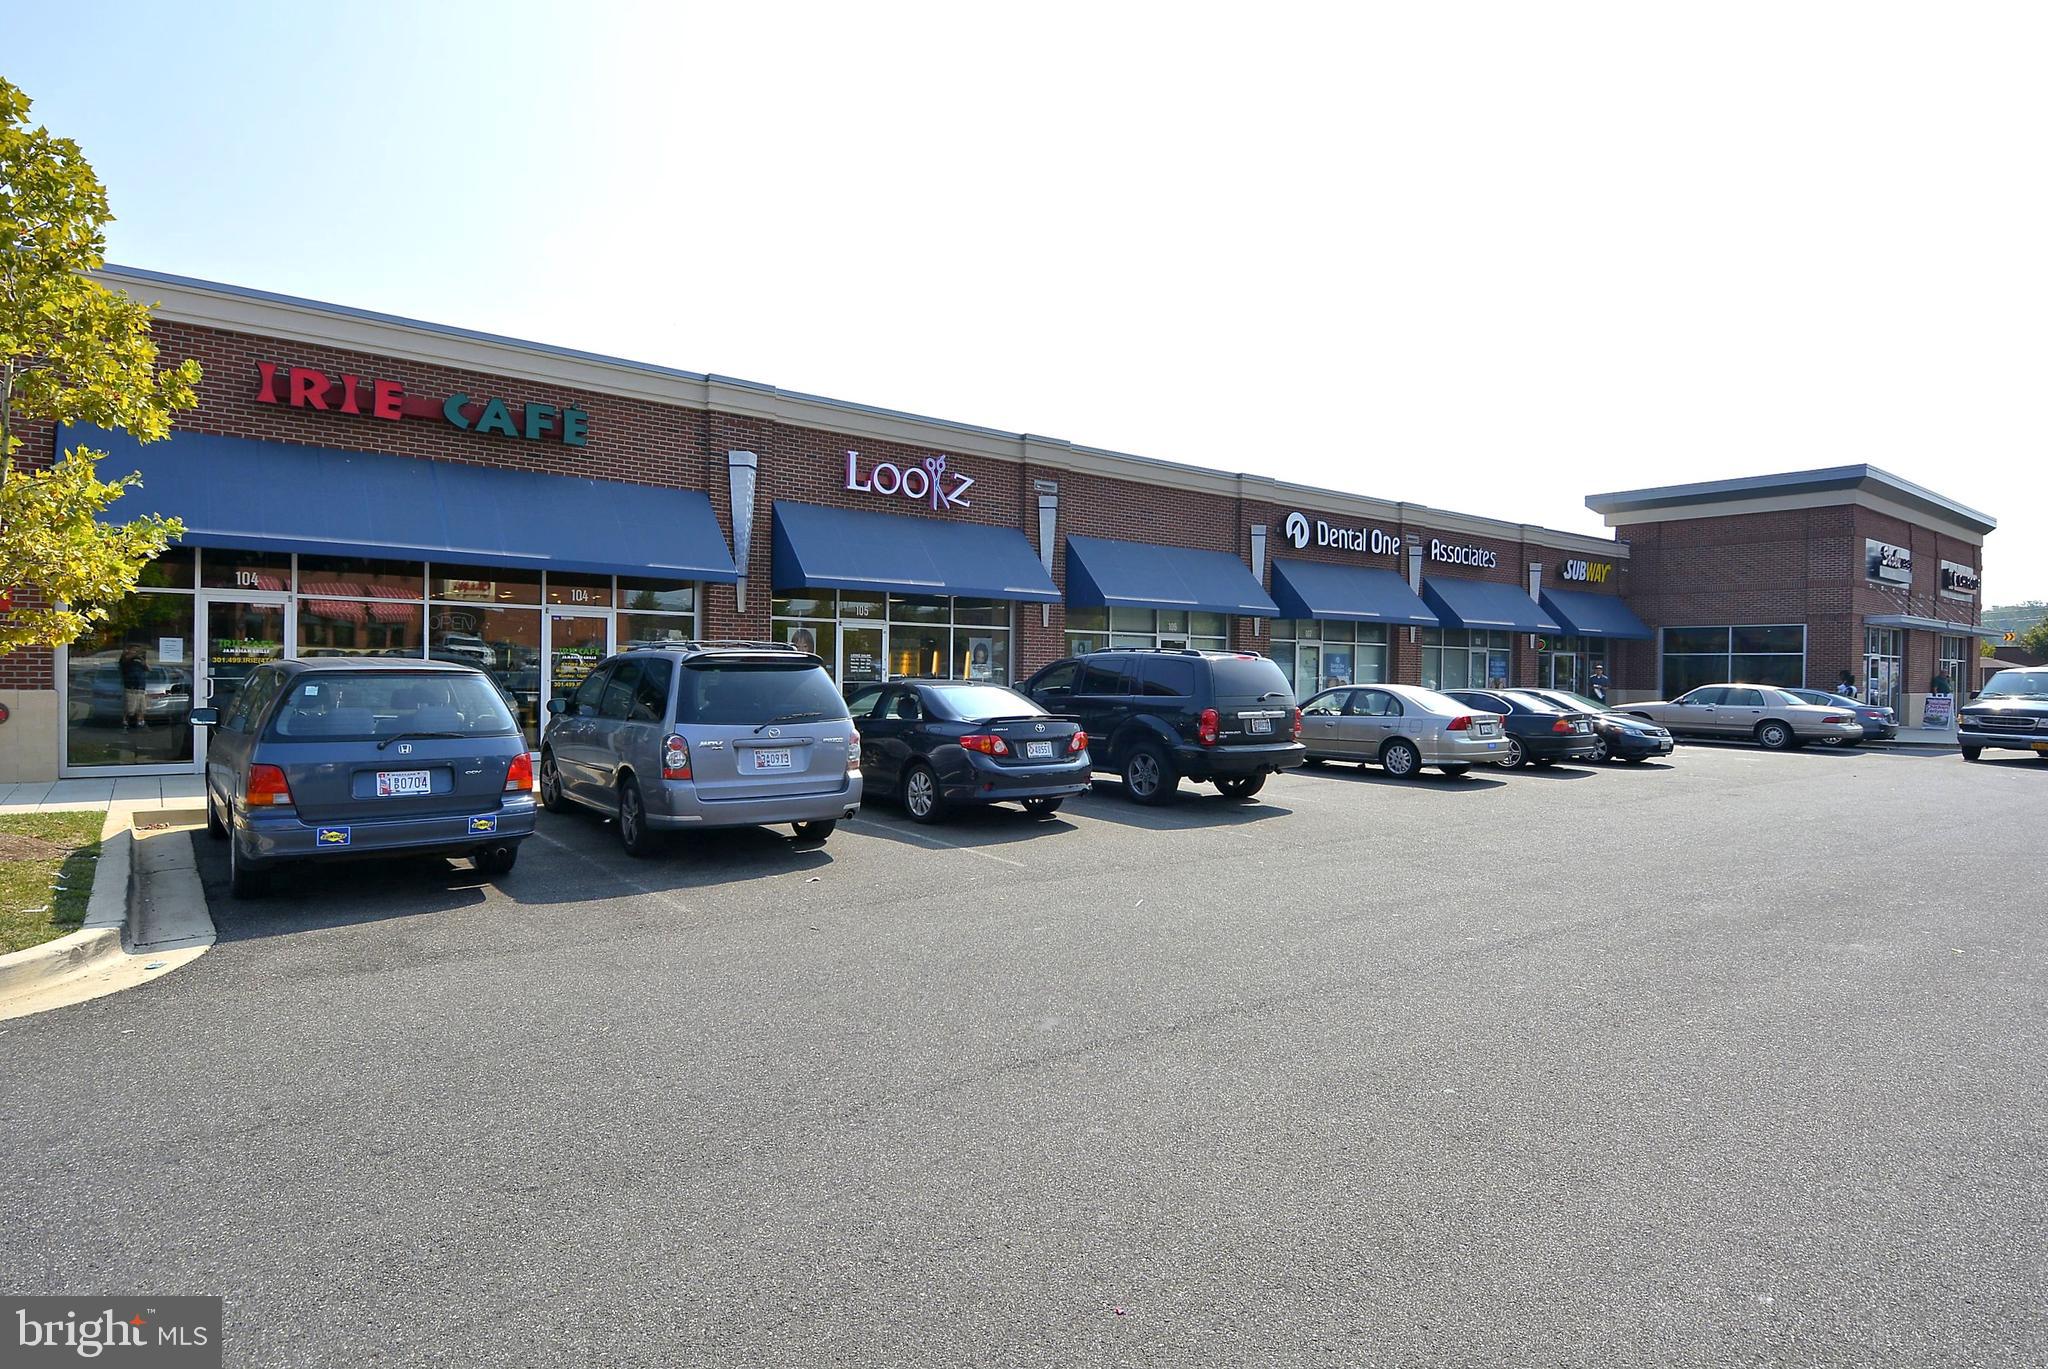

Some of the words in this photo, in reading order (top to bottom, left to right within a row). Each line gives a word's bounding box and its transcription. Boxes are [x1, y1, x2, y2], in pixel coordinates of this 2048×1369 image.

[255, 361, 403, 420] IRIE
[443, 393, 589, 447] CAFÉ
[1317, 520, 1366, 551] Dental
[1371, 529, 1400, 555] One
[1431, 538, 1497, 568] Associates
[236, 571, 259, 586] 104
[1563, 559, 1611, 583] SUBWAY
[571, 589, 588, 602] 104
[855, 605, 869, 616] 105
[430, 615, 473, 631] OPEN
